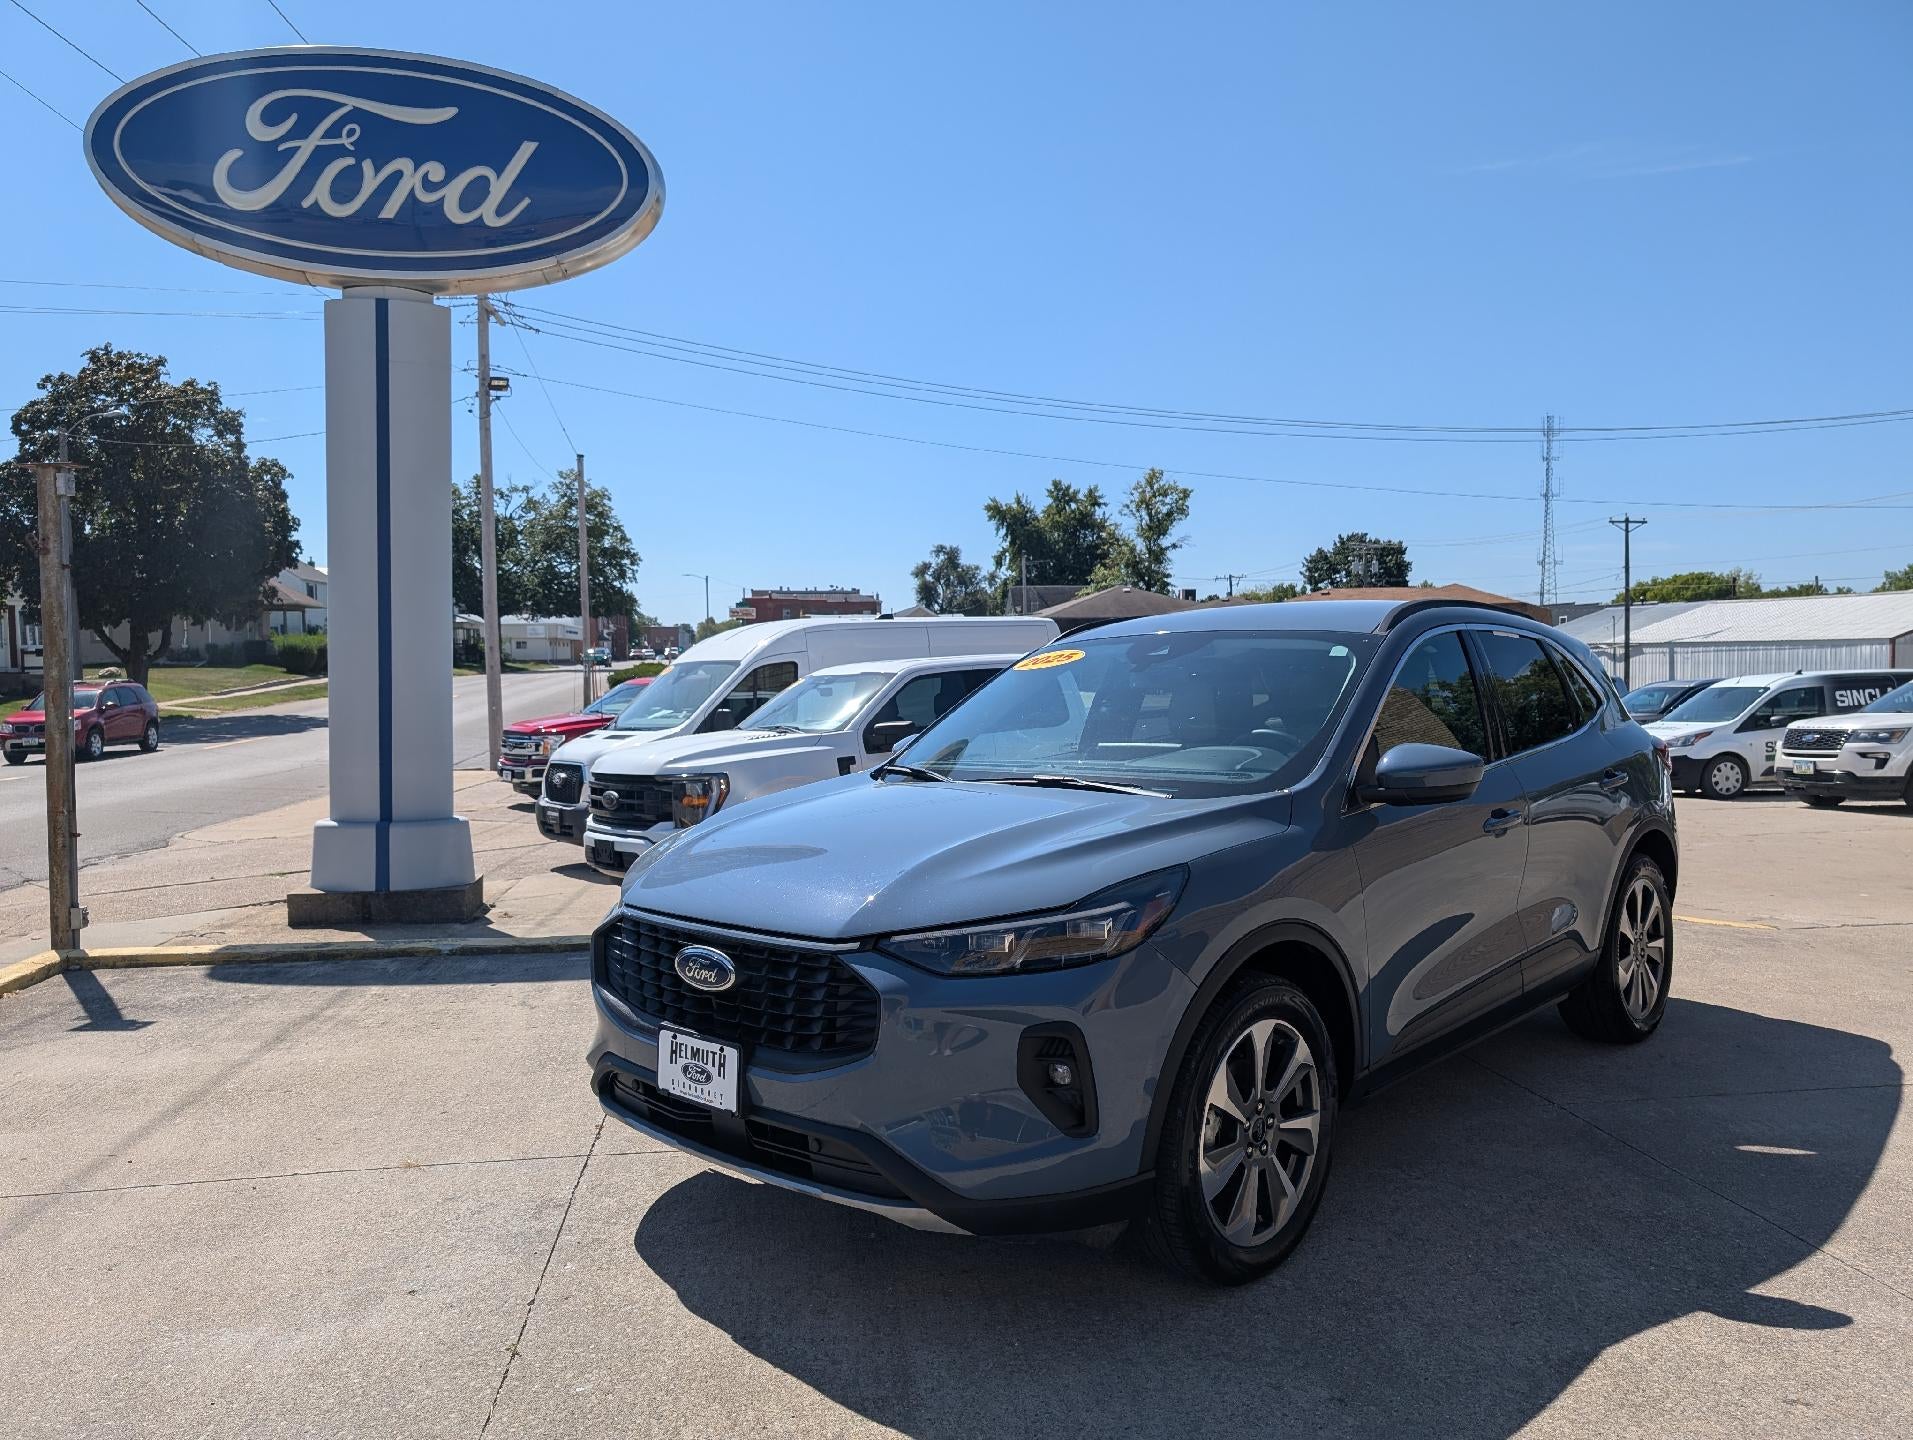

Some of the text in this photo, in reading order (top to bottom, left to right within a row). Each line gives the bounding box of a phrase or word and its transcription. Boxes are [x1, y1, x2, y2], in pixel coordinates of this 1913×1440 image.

[213, 88, 539, 227] Ford
[1017, 652, 1079, 667] 2025
[1835, 687, 1893, 707] SINC
[685, 956, 719, 983] Ford
[669, 1039, 727, 1081] HELMUTH
[686, 1065, 707, 1083] Ford
